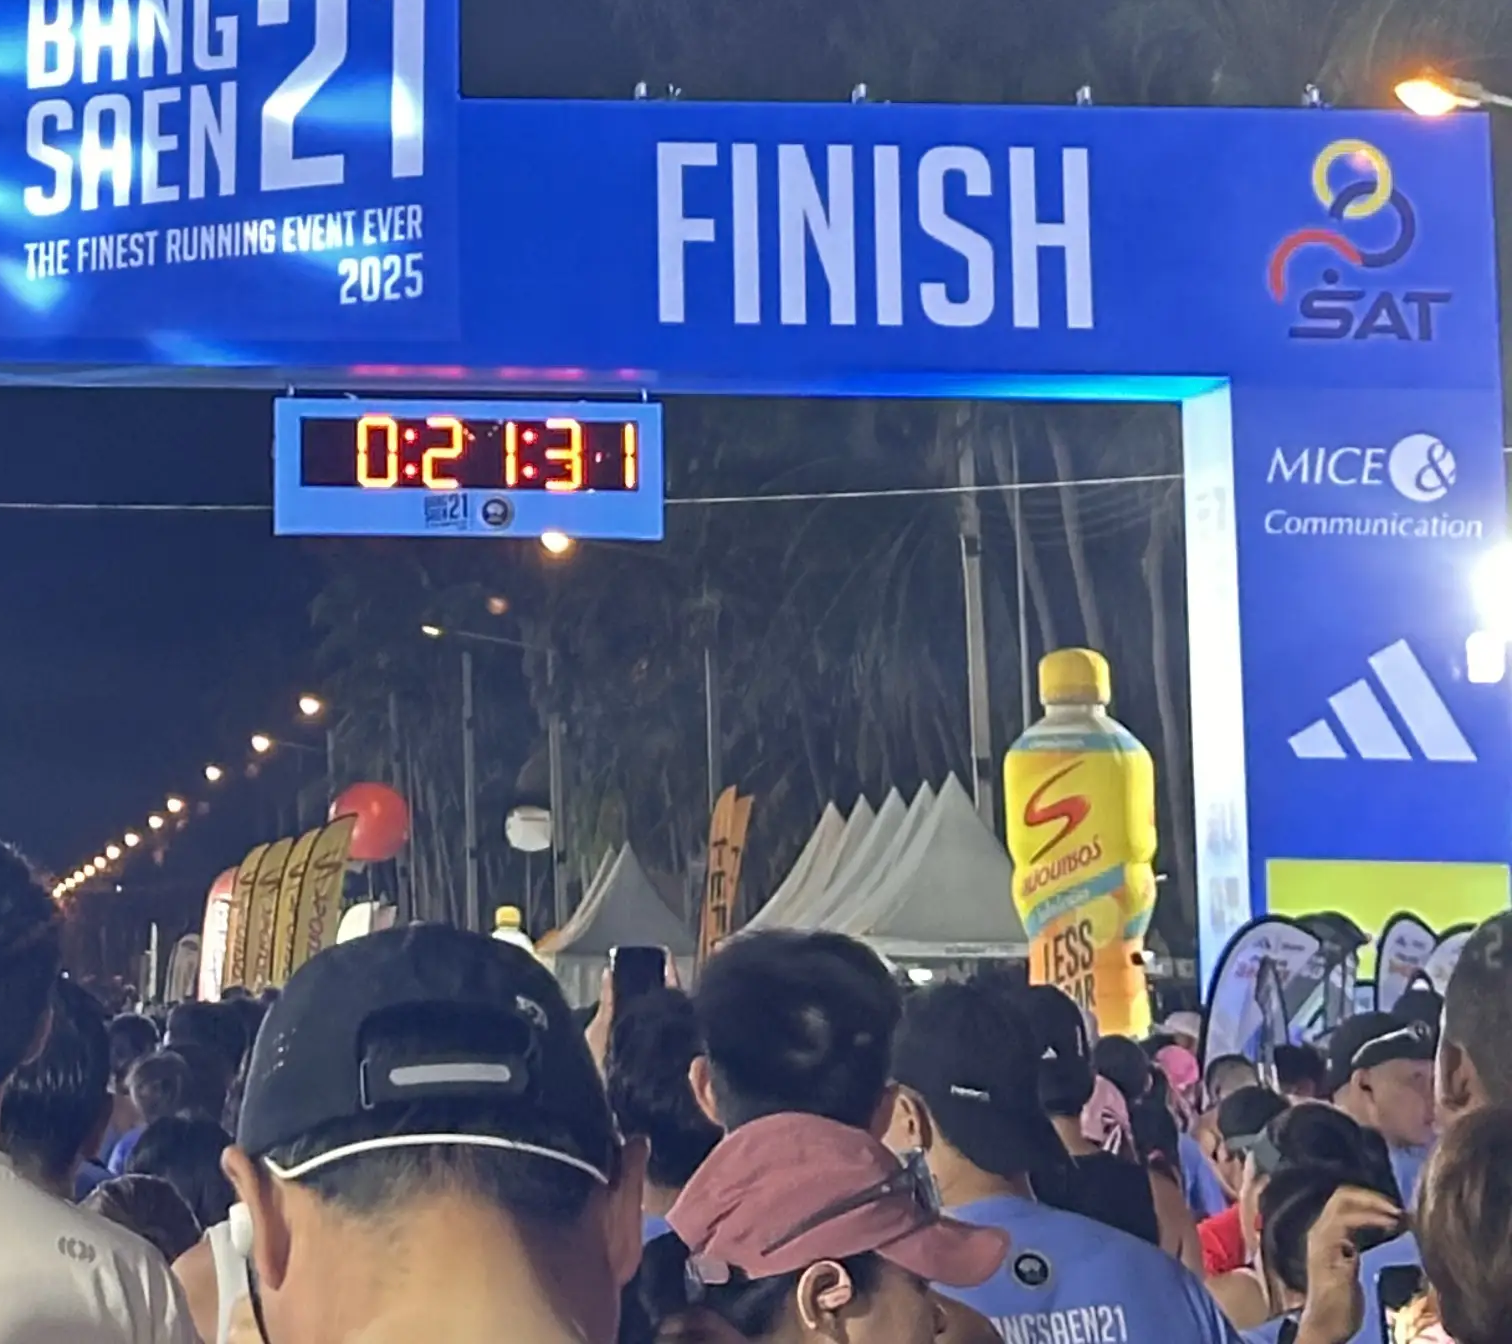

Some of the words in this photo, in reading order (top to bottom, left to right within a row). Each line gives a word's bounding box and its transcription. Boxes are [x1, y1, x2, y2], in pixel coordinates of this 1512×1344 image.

[23, 81, 238, 217] SAEN
[24, 238, 69, 281] THE
[77, 230, 159, 273] FINEST
[166, 218, 276, 263] RUNNING
[282, 210, 356, 253] EVENT
[362, 203, 423, 245] EVER
[656, 140, 1094, 330] FINISH
[337, 252, 424, 305] 2025
[1288, 291, 1452, 342] SAT
[1265, 446, 1387, 486] MICE
[1263, 509, 1485, 539] Communication
